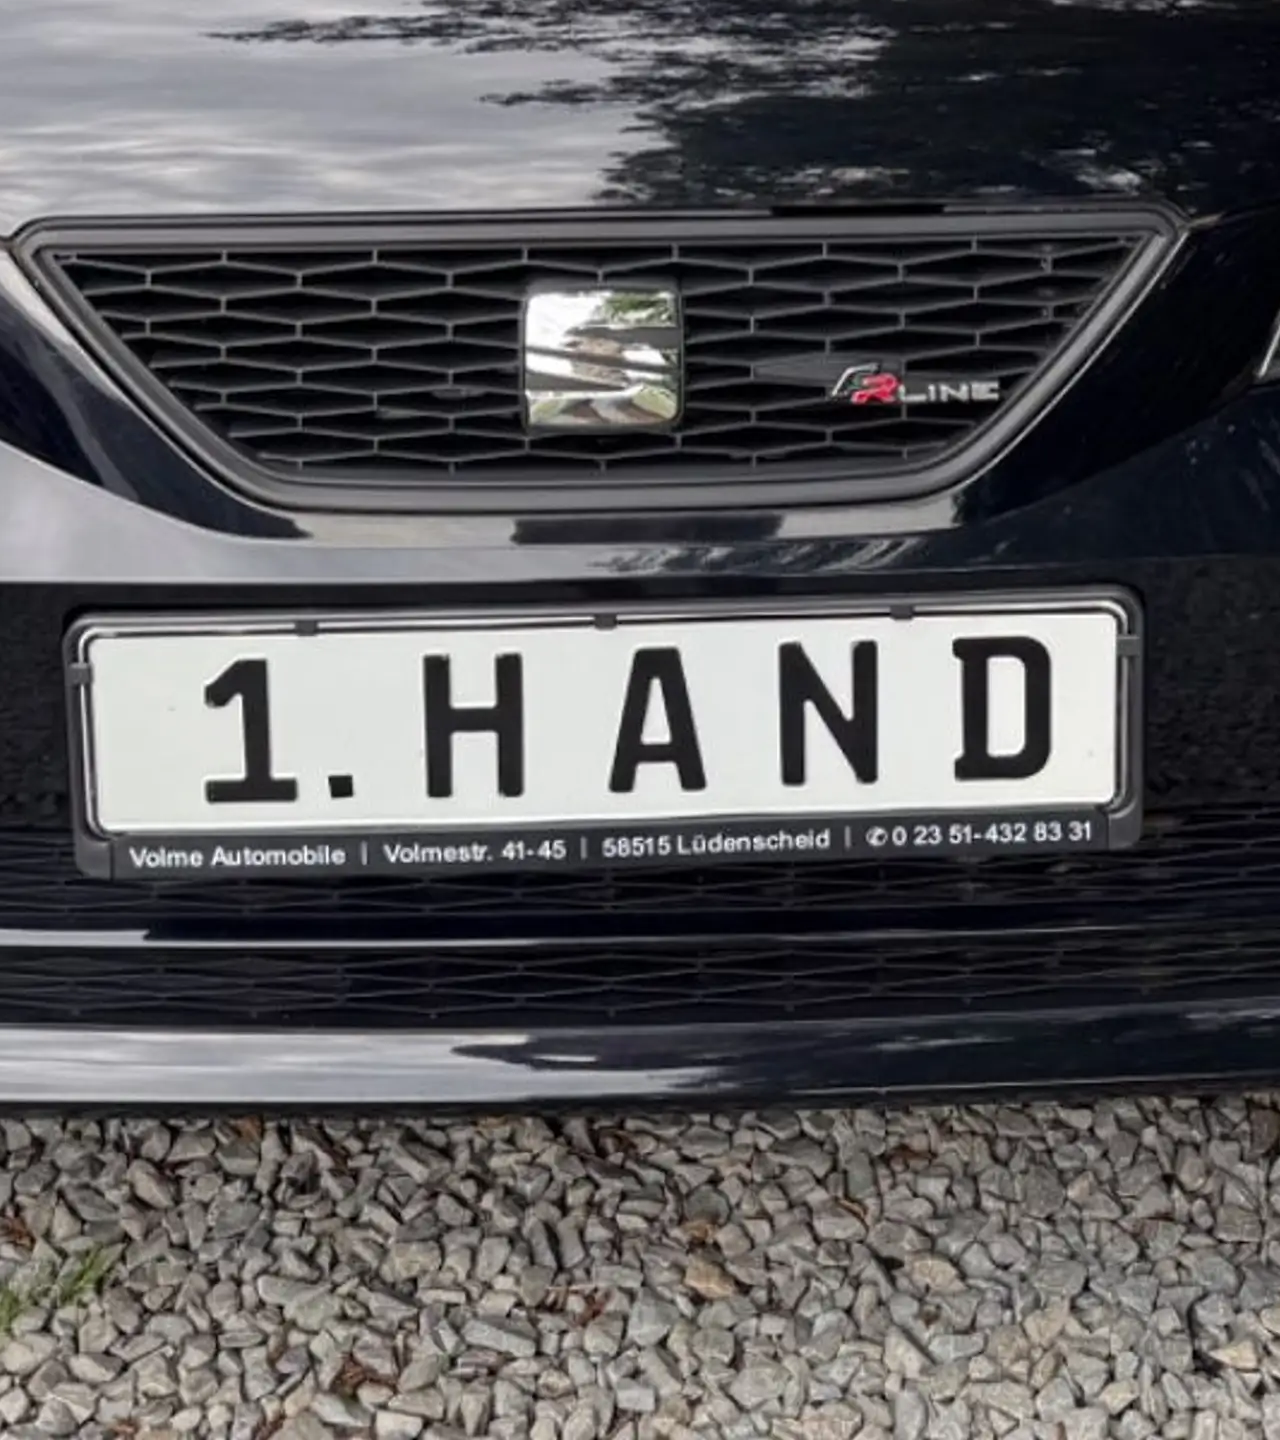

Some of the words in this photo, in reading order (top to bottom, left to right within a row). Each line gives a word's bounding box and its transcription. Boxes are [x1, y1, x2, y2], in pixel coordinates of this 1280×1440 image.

[204, 658, 355, 803] 1.
[128, 845, 204, 868] Volme
[210, 844, 346, 867] Automobile
[382, 840, 493, 864] Volmestr.
[500, 838, 567, 860] 41-45
[602, 834, 672, 858] 58515
[677, 828, 831, 855] Lüdenscheid
[913, 824, 943, 846] 23
[948, 822, 1027, 845] 51-432
[1032, 820, 1063, 842] 83
[1068, 819, 1091, 841] 31
